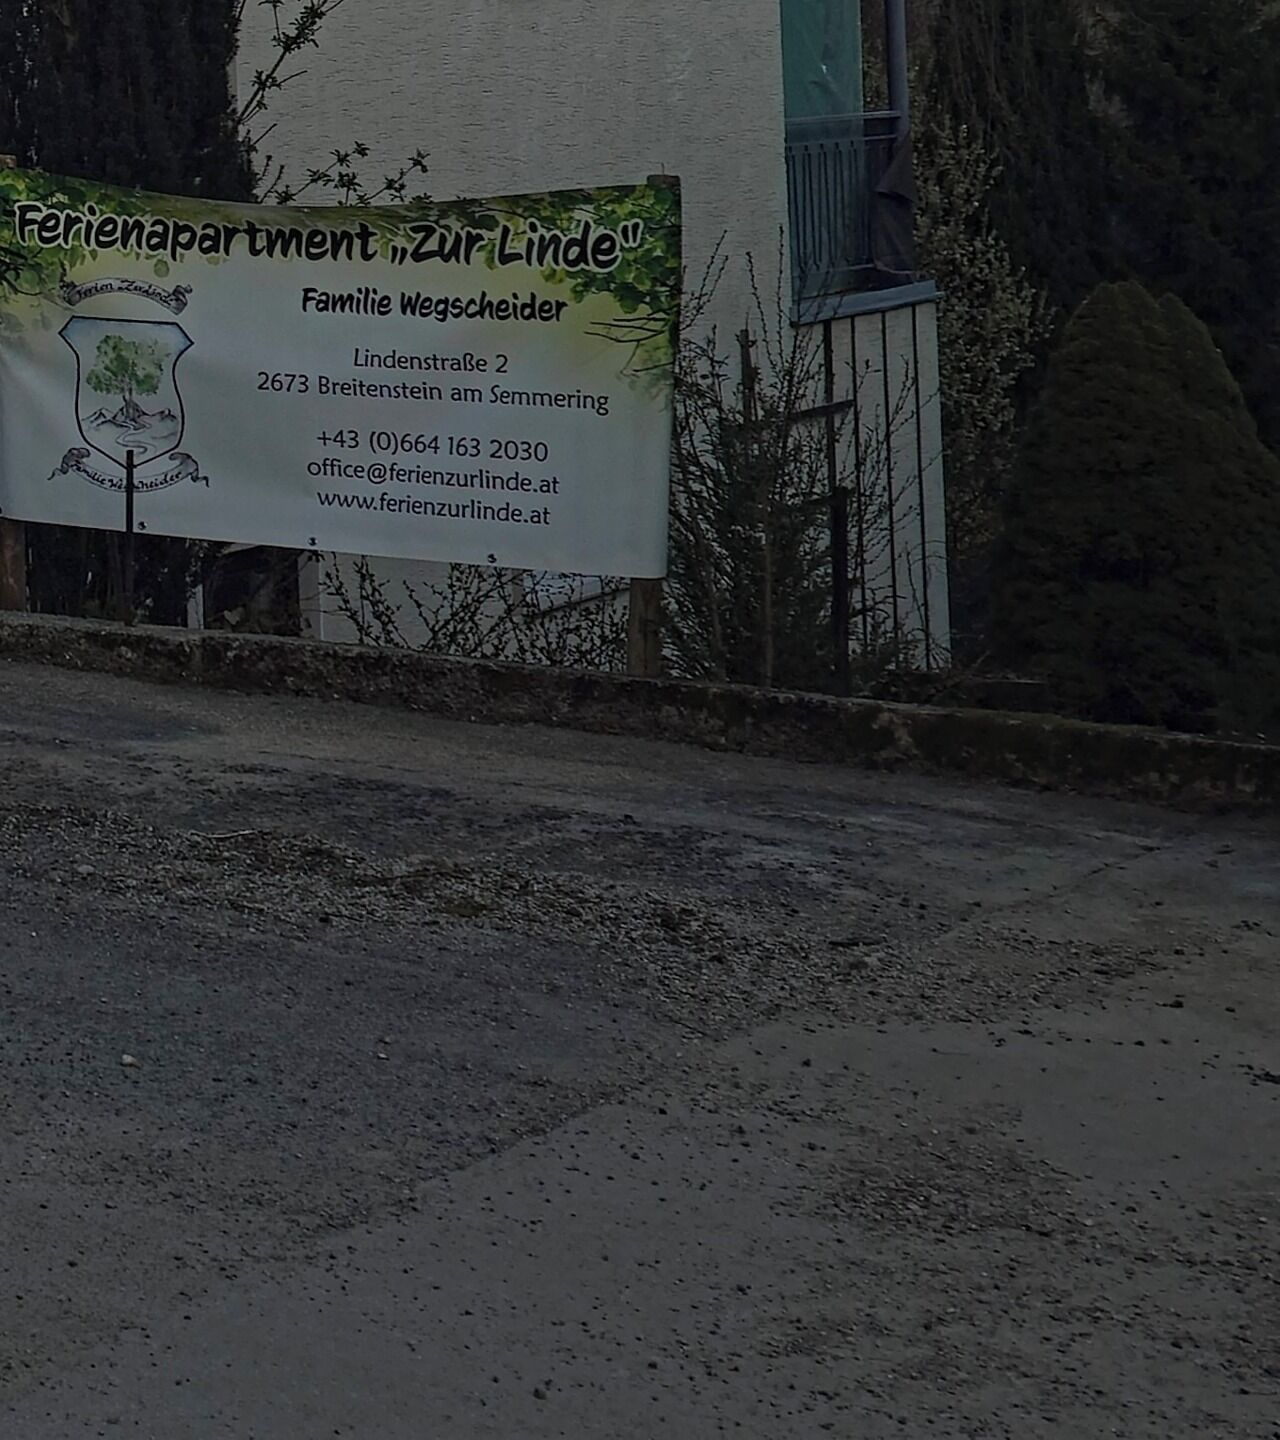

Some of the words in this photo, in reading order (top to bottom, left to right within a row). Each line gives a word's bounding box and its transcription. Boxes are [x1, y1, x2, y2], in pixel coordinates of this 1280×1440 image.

[17, 204, 378, 261] Ferienapartment
[302, 287, 393, 316] Familie
[400, 291, 568, 323] Wegscheider
[354, 348, 488, 372] Lindenstraße
[495, 354, 509, 373] 2
[257, 372, 309, 393] 2673
[318, 375, 443, 400] Breitenstein
[451, 387, 483, 403] am
[490, 384, 609, 416] Semmering
[317, 430, 359, 449] +43
[369, 431, 441, 455] (0)664
[448, 437, 481, 457] 163
[489, 439, 549, 462] 2030
[307, 458, 560, 494] office@ferienzurlinde.at
[317, 491, 550, 525] www.ferienzurlinde.at
